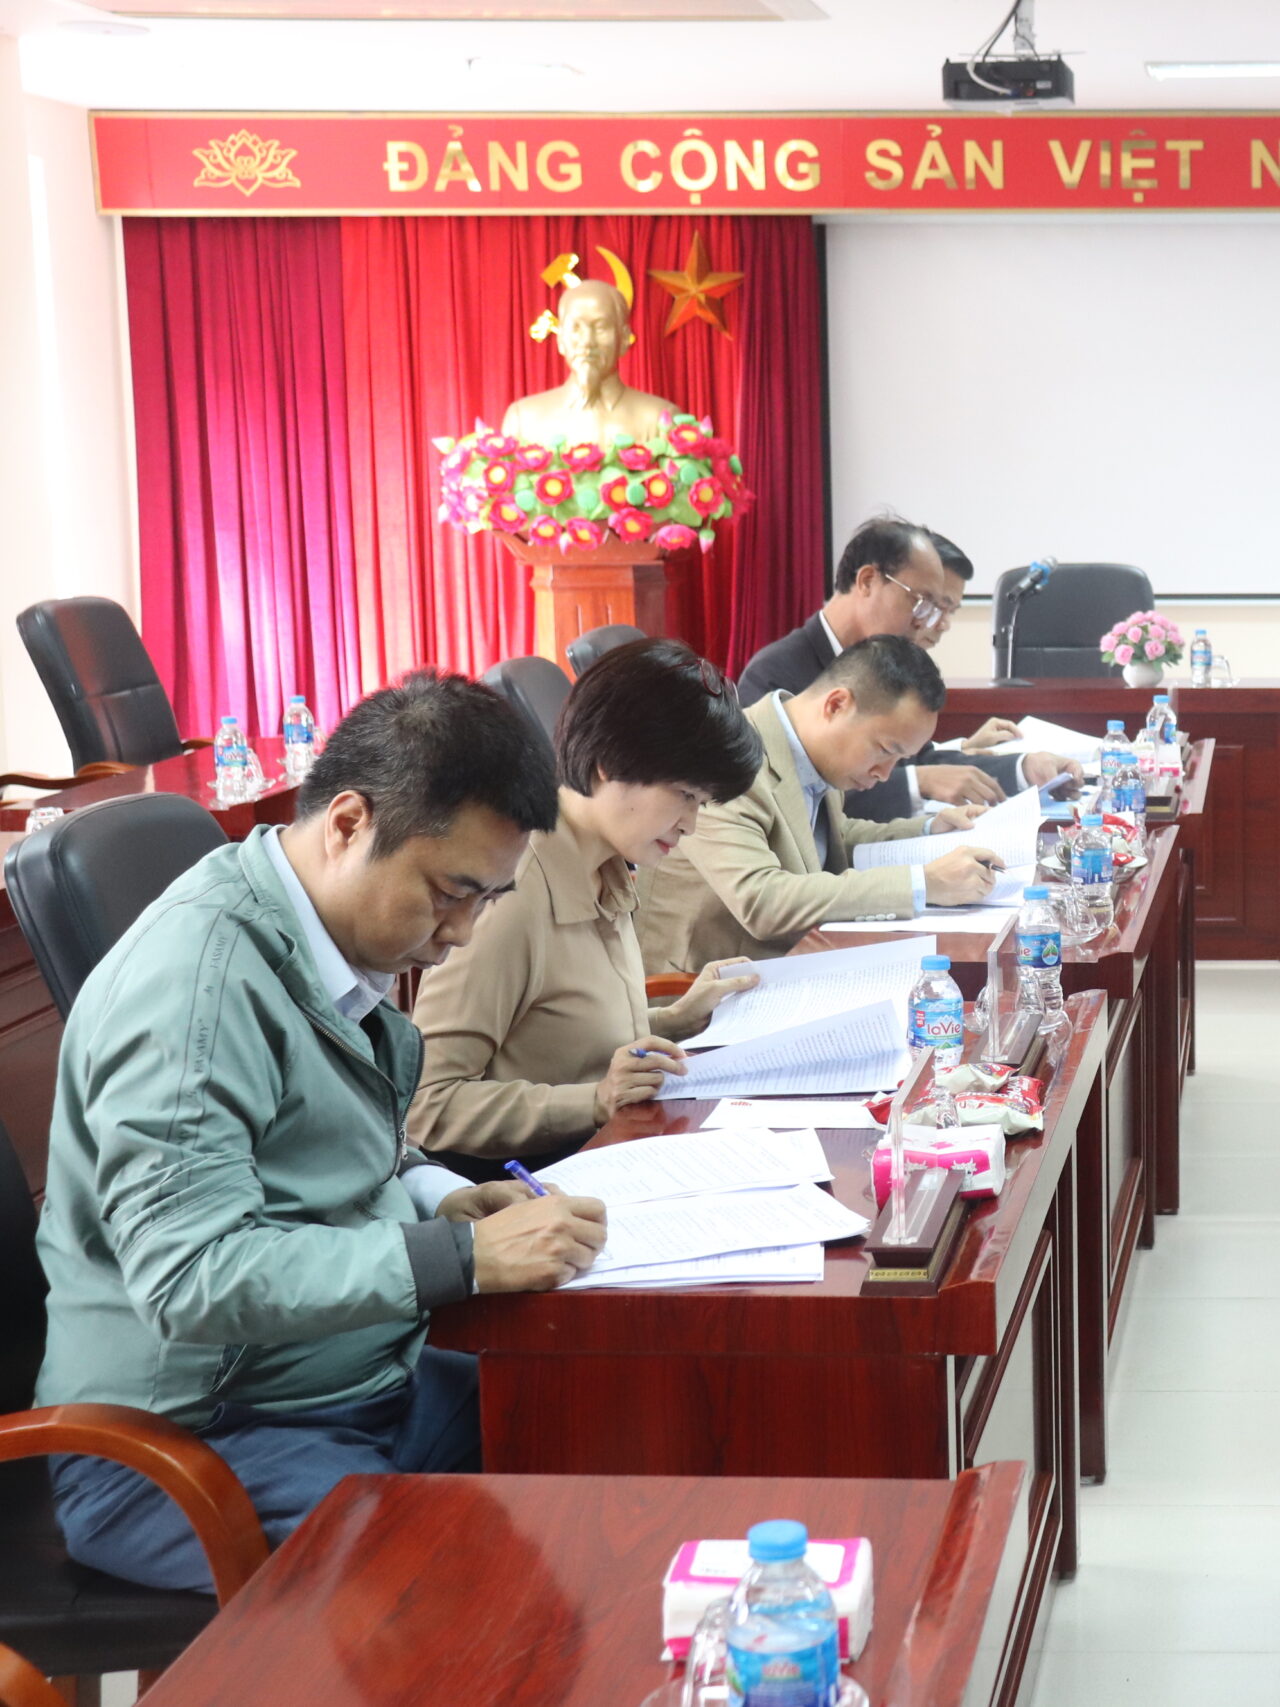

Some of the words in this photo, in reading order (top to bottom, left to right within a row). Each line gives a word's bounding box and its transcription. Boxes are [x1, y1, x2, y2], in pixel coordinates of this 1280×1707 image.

[383, 125, 583, 193] ĐẢNG
[619, 127, 822, 206] CỘNG
[864, 124, 1005, 191] SẢN
[1048, 129, 1205, 203] VIỆT
[927, 1020, 961, 1036] laVie
